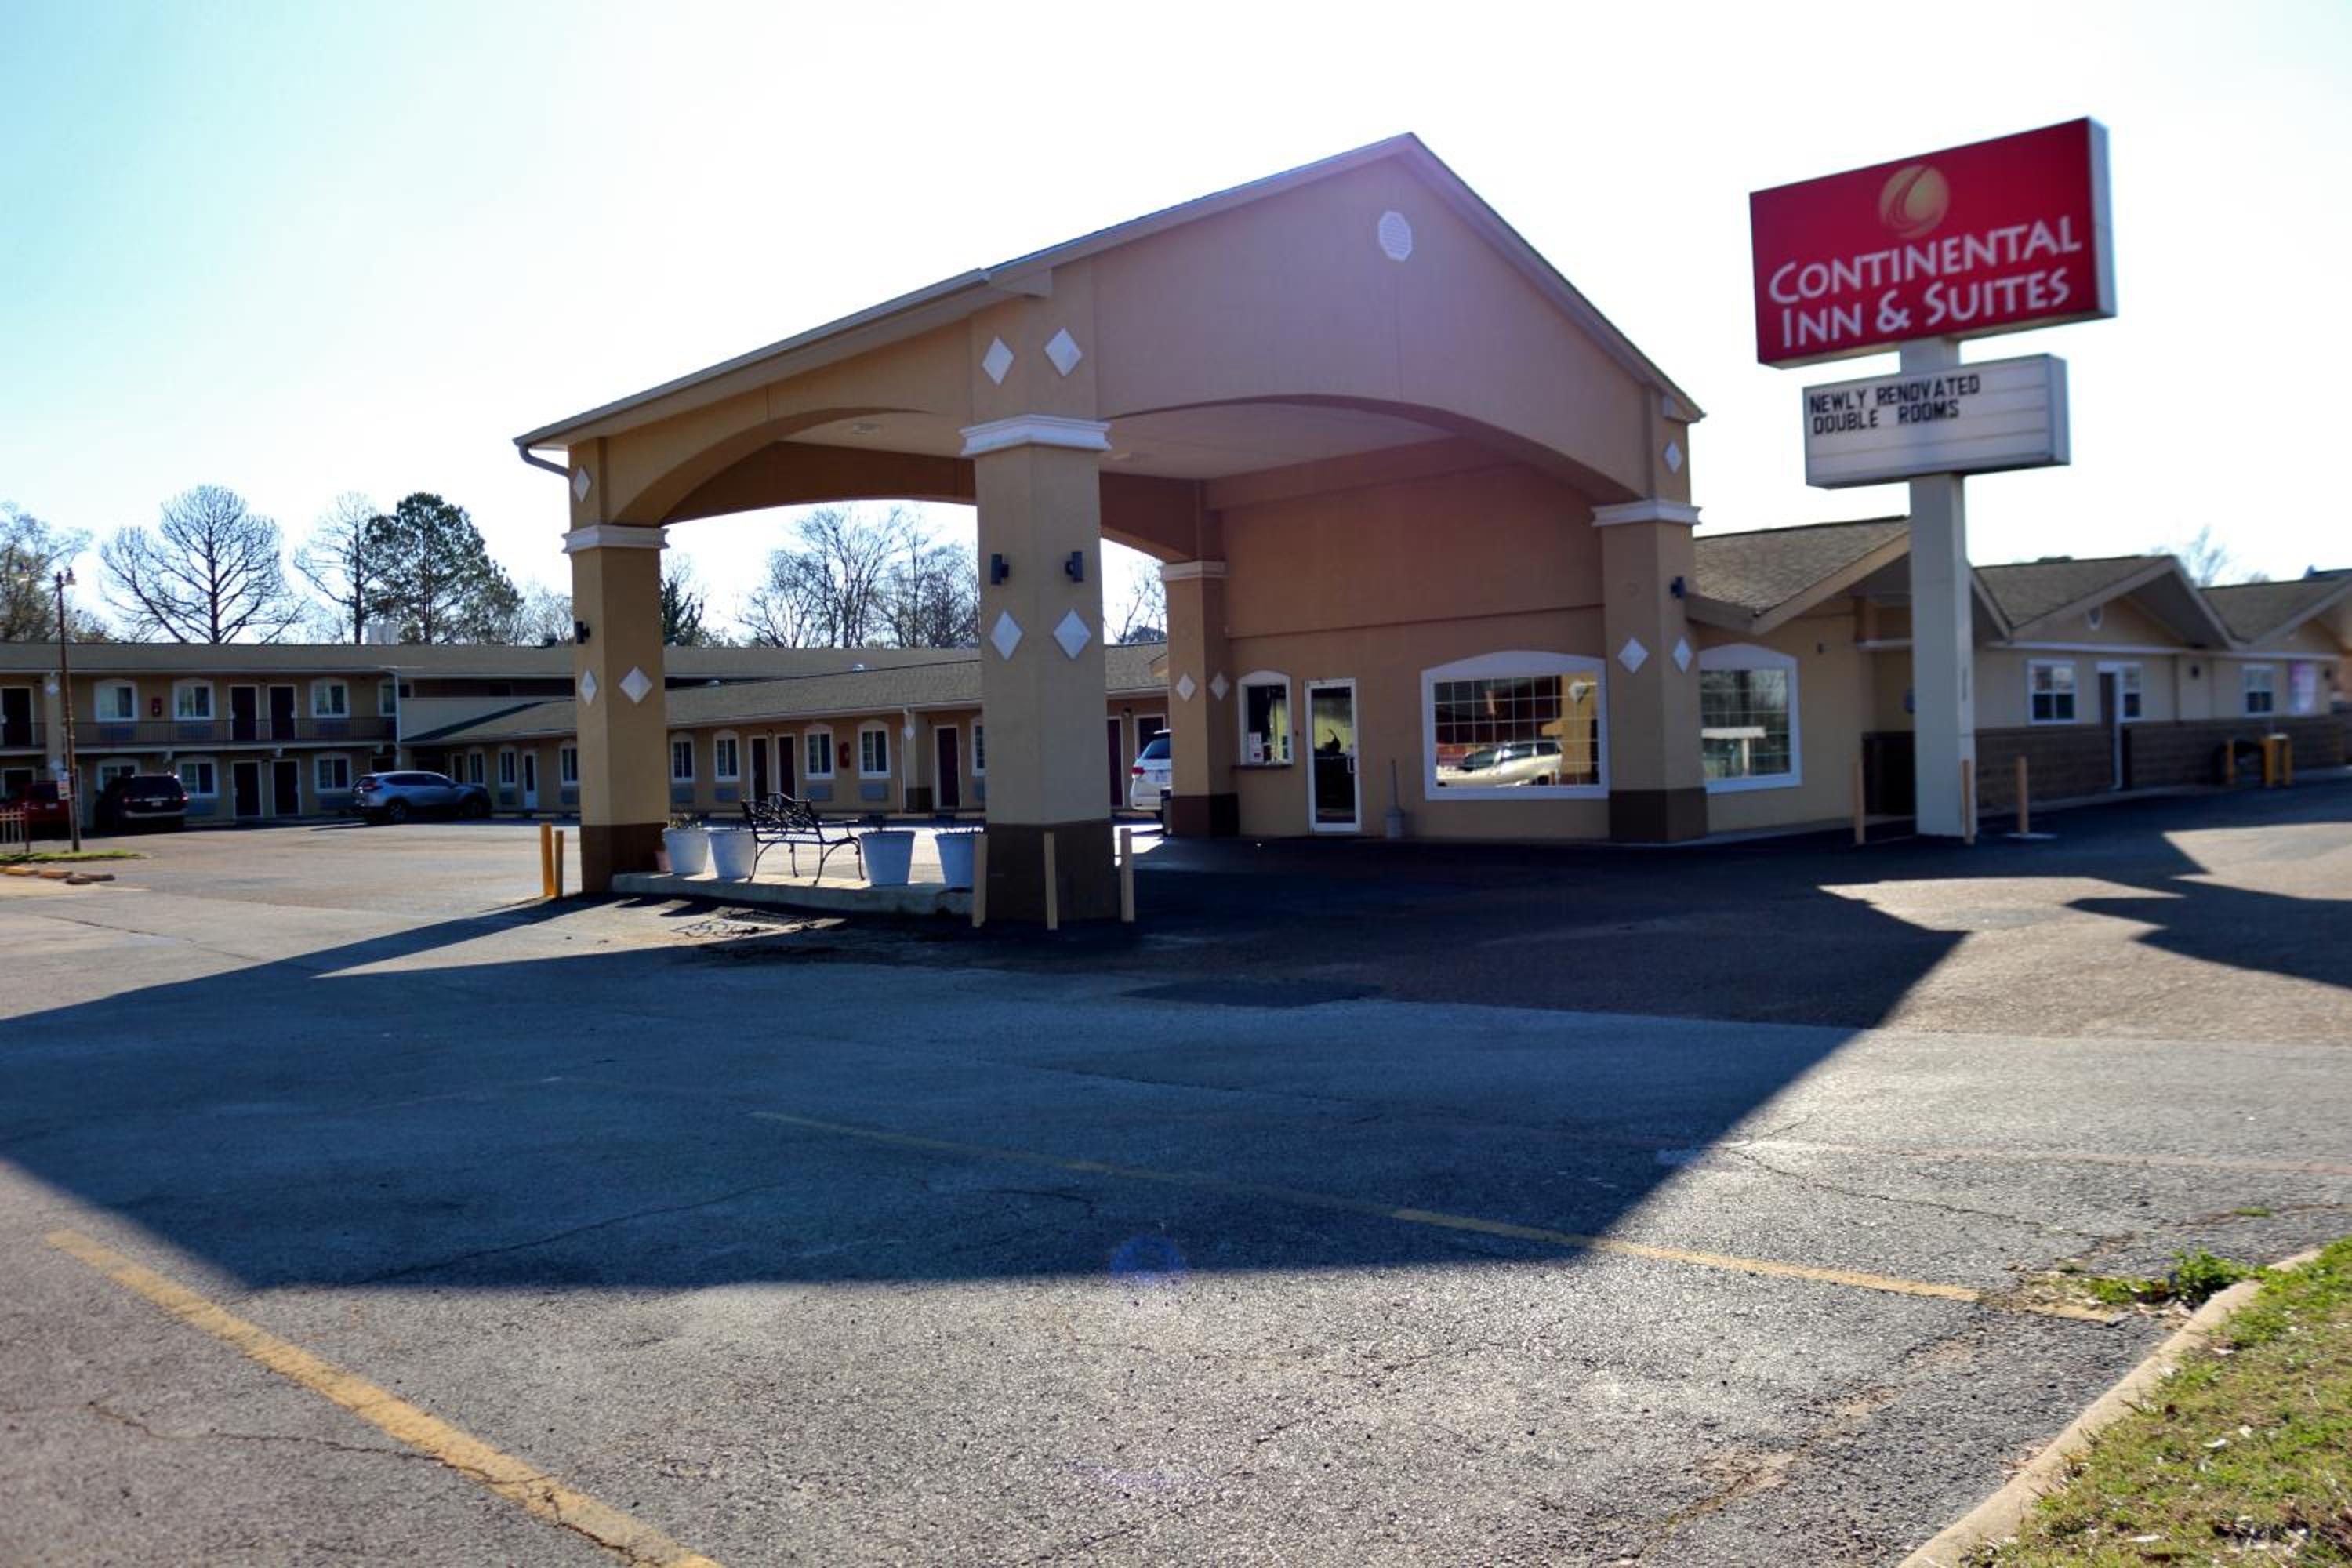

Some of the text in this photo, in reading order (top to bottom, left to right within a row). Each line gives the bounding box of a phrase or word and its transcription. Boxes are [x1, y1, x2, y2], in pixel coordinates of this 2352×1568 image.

[1769, 216, 2082, 303] CONTINENTAL
[1783, 267, 2071, 348] INN & SUITES
[1809, 374, 1980, 414] NEWLY RENOVATED
[1813, 399, 1958, 434] DOUBLE ROOMS
